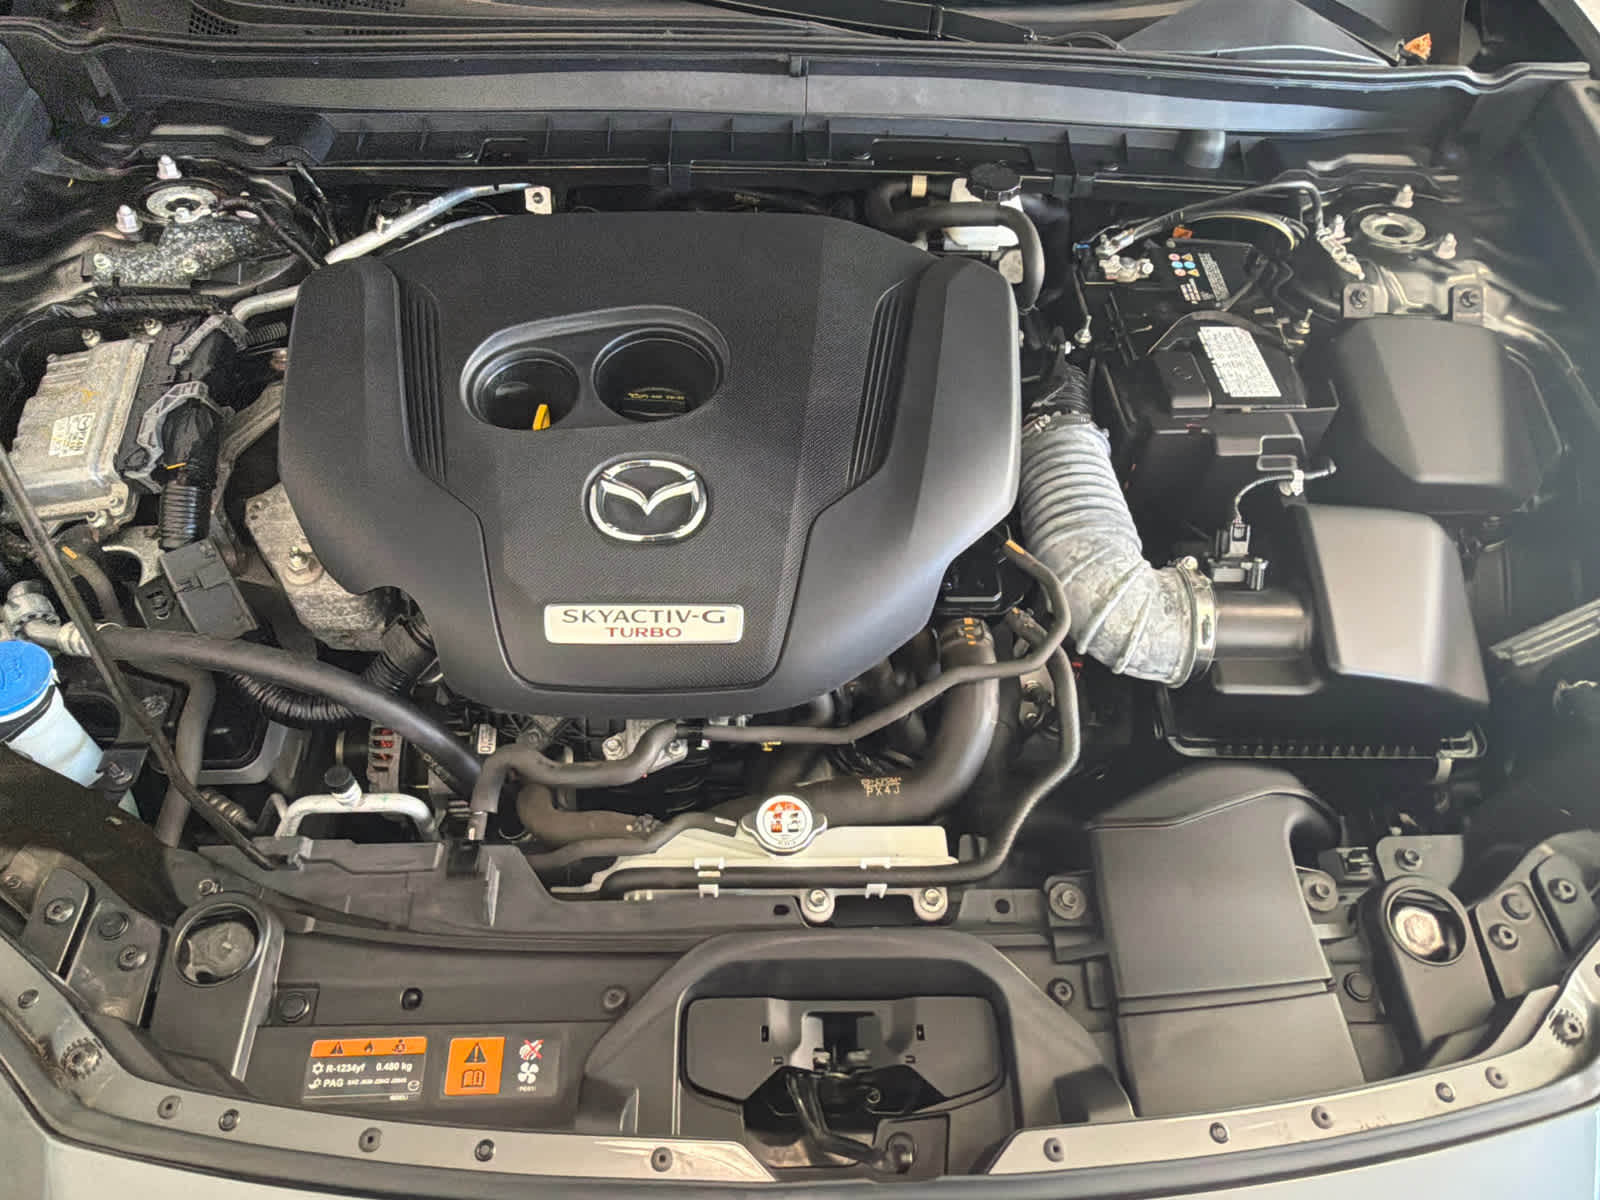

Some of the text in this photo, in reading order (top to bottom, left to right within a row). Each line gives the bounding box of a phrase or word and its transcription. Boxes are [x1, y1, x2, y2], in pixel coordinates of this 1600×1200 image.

[561, 609, 727, 624] SKYACTIV-G
[605, 626, 682, 638] TURBO
[325, 1062, 366, 1074] R-1234yf
[401, 1062, 413, 1073] kg
[323, 1079, 344, 1088] PAG
